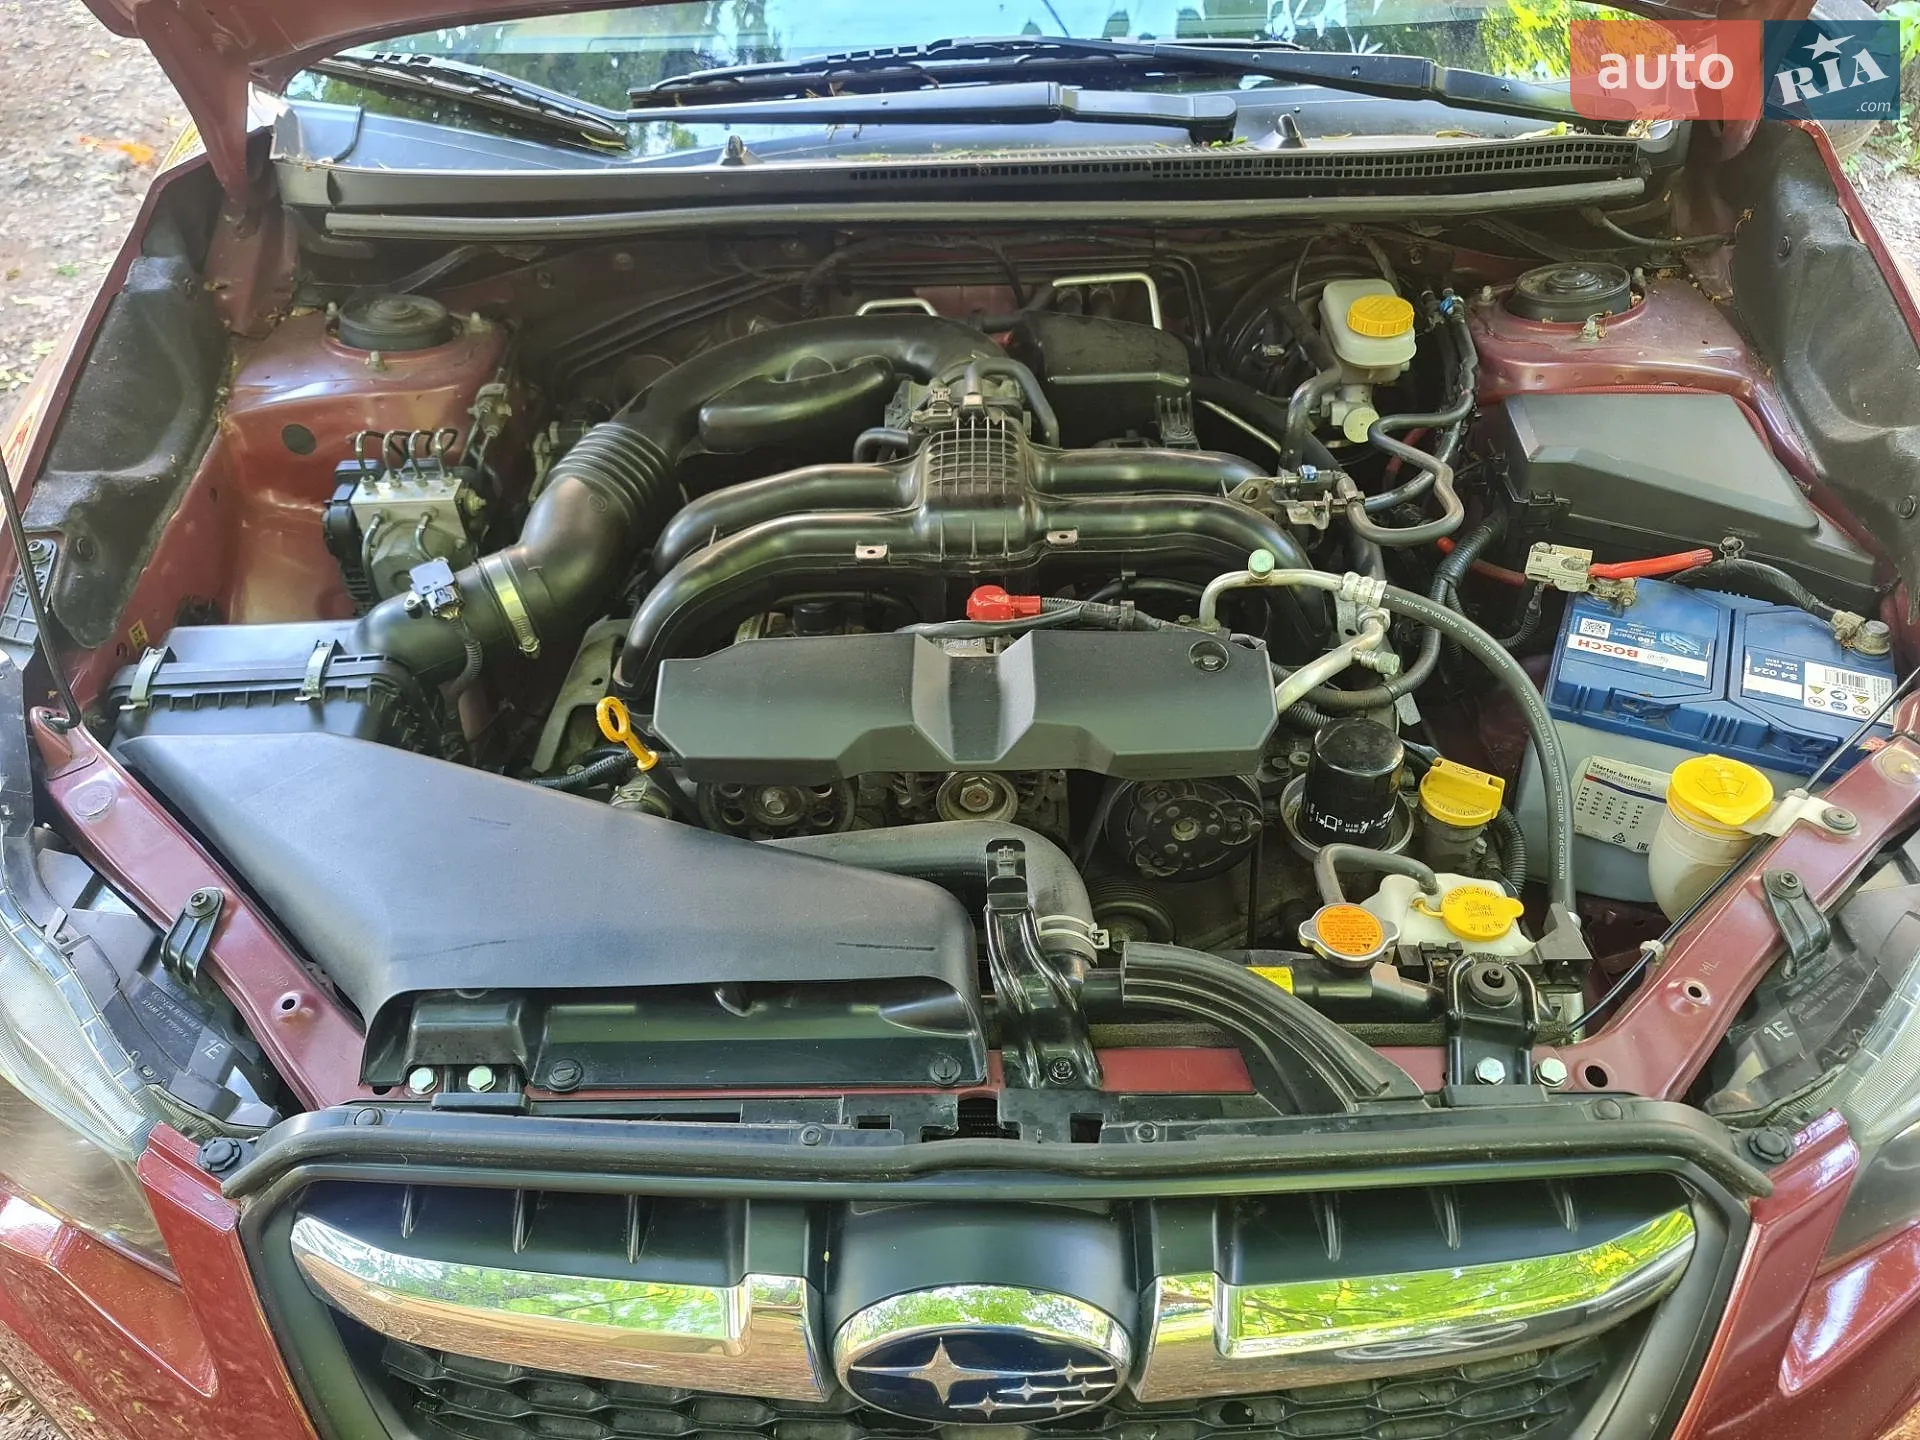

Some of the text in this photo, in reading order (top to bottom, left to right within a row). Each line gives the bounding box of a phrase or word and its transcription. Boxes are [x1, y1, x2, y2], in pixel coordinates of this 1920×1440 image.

[1577, 639, 1639, 660] BOSCH
[1753, 666, 1778, 677] 024
[1592, 761, 1652, 786] Starter batteries
